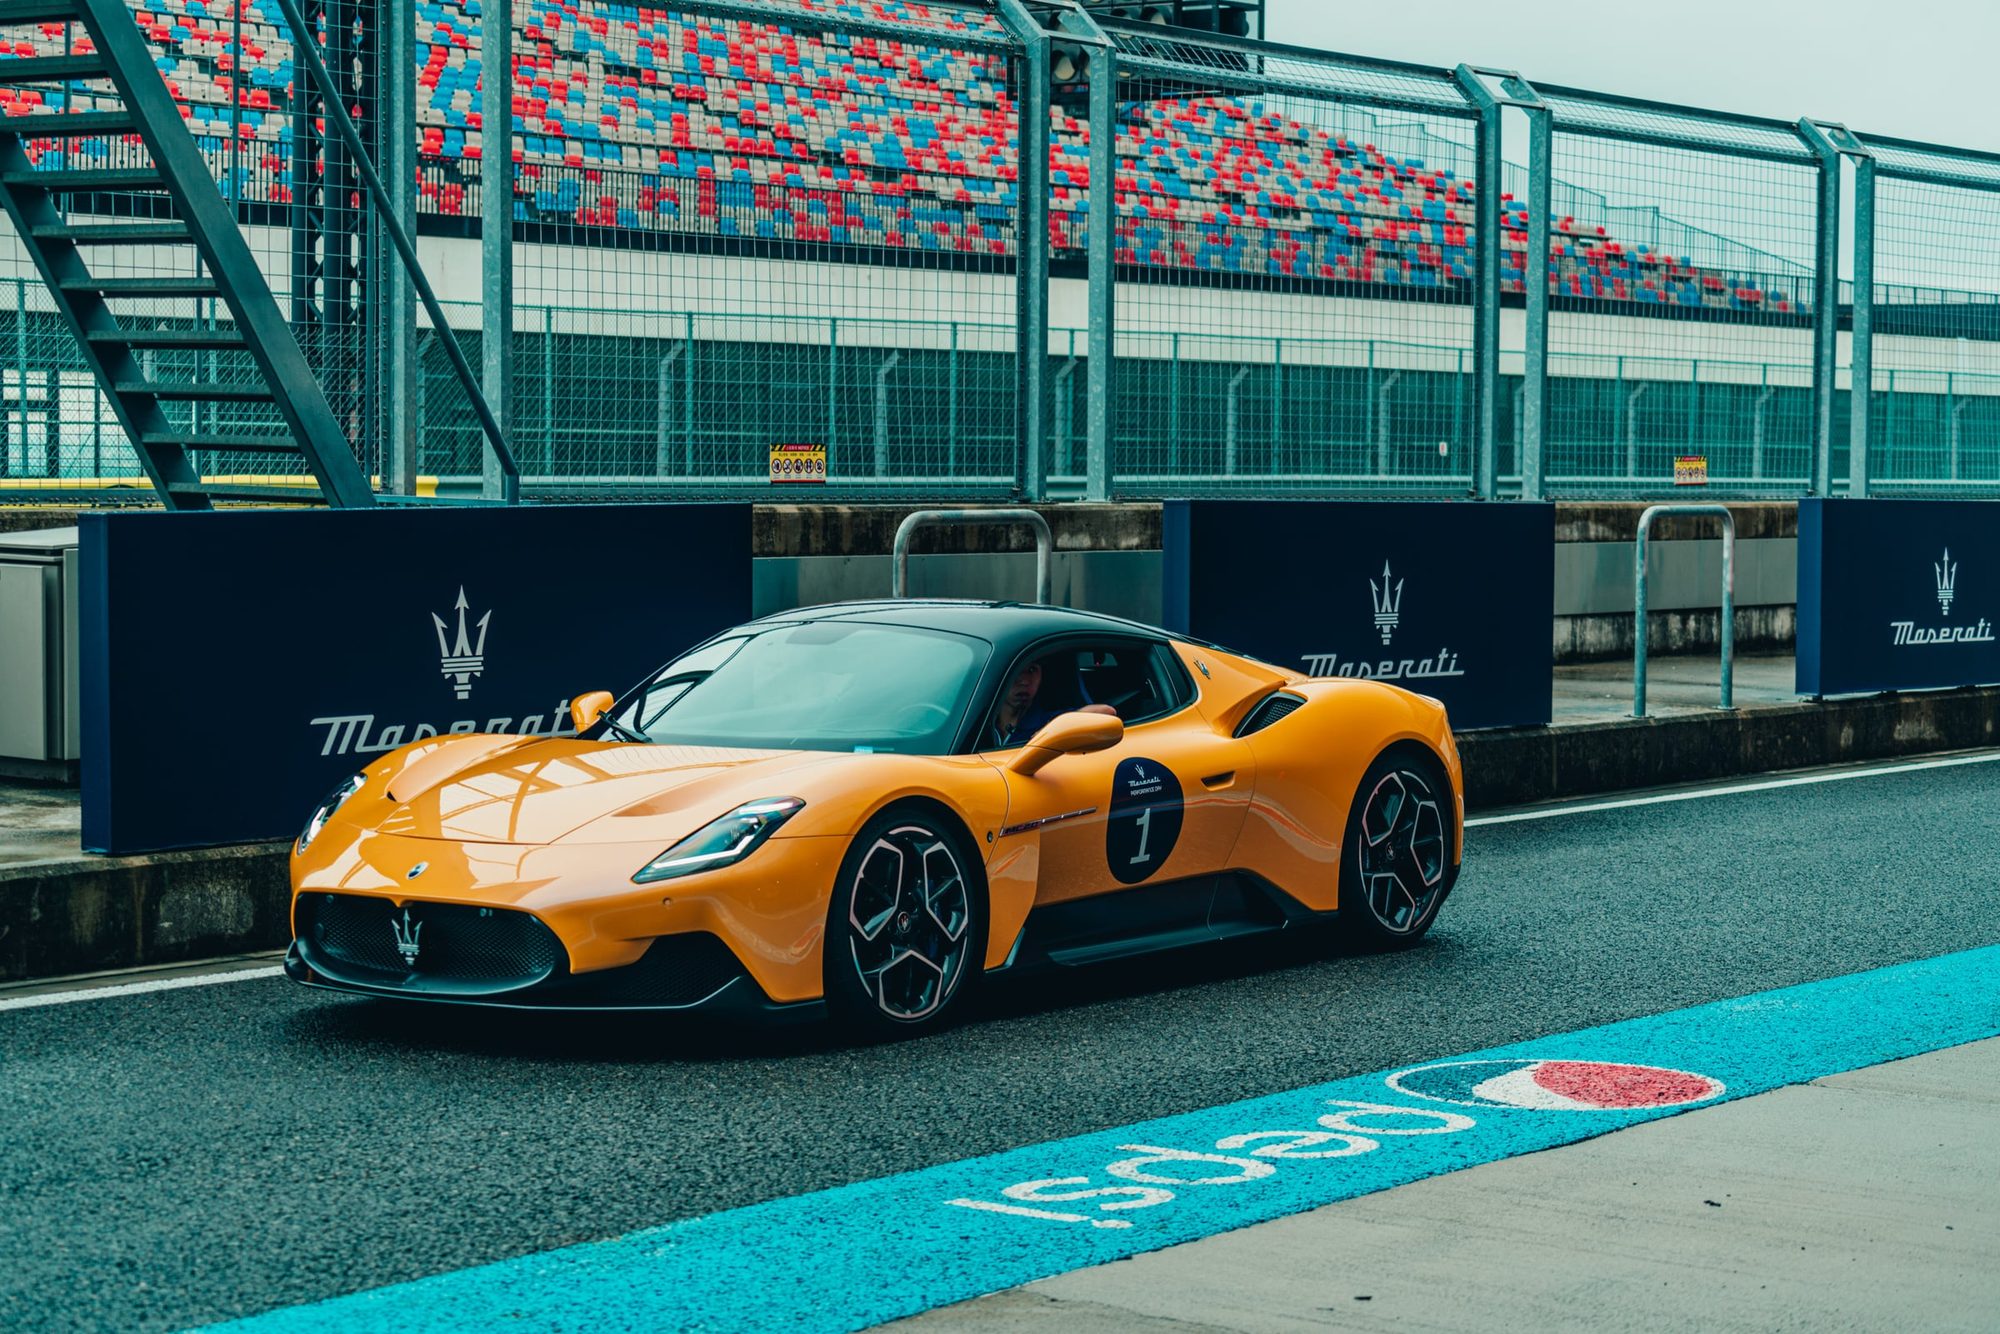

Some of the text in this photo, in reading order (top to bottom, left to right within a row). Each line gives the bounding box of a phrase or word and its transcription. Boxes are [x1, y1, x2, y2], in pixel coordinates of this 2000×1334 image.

[1890, 618, 1995, 645] Maserati
[1301, 648, 1464, 680] Maserati
[310, 699, 577, 755] Maserat
[1129, 807, 1151, 864] 1
